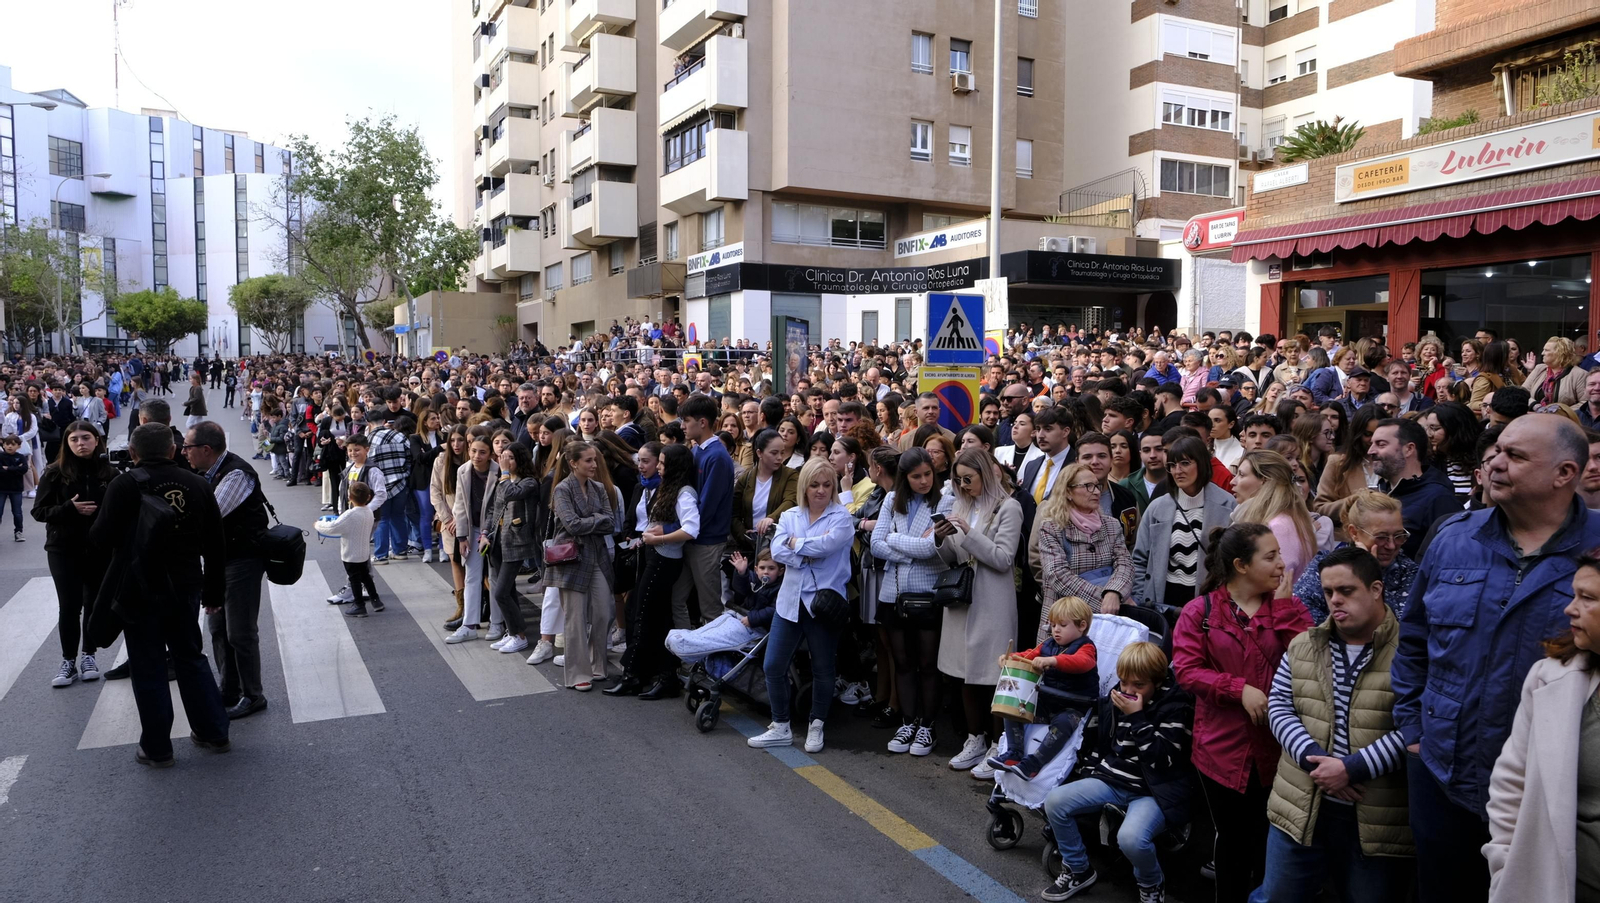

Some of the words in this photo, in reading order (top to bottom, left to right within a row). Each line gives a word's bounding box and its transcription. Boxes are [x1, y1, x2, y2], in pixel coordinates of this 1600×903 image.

[1358, 164, 1404, 180] CAFETERÍA
[1357, 181, 1375, 189] DESDE
[1376, 178, 1391, 186] 1990
[950, 229, 982, 242] AUDITORES
[722, 248, 743, 260] AUDITORES
[1091, 260, 1101, 270] Dr.
[1102, 261, 1130, 271] Antonio
[1146, 264, 1163, 273] Luna
[848, 270, 867, 283] Dr.
[871, 269, 925, 282] Antonio
[947, 265, 970, 278] Luna
[883, 283, 888, 292] y
[927, 278, 964, 290] Ortopédica
